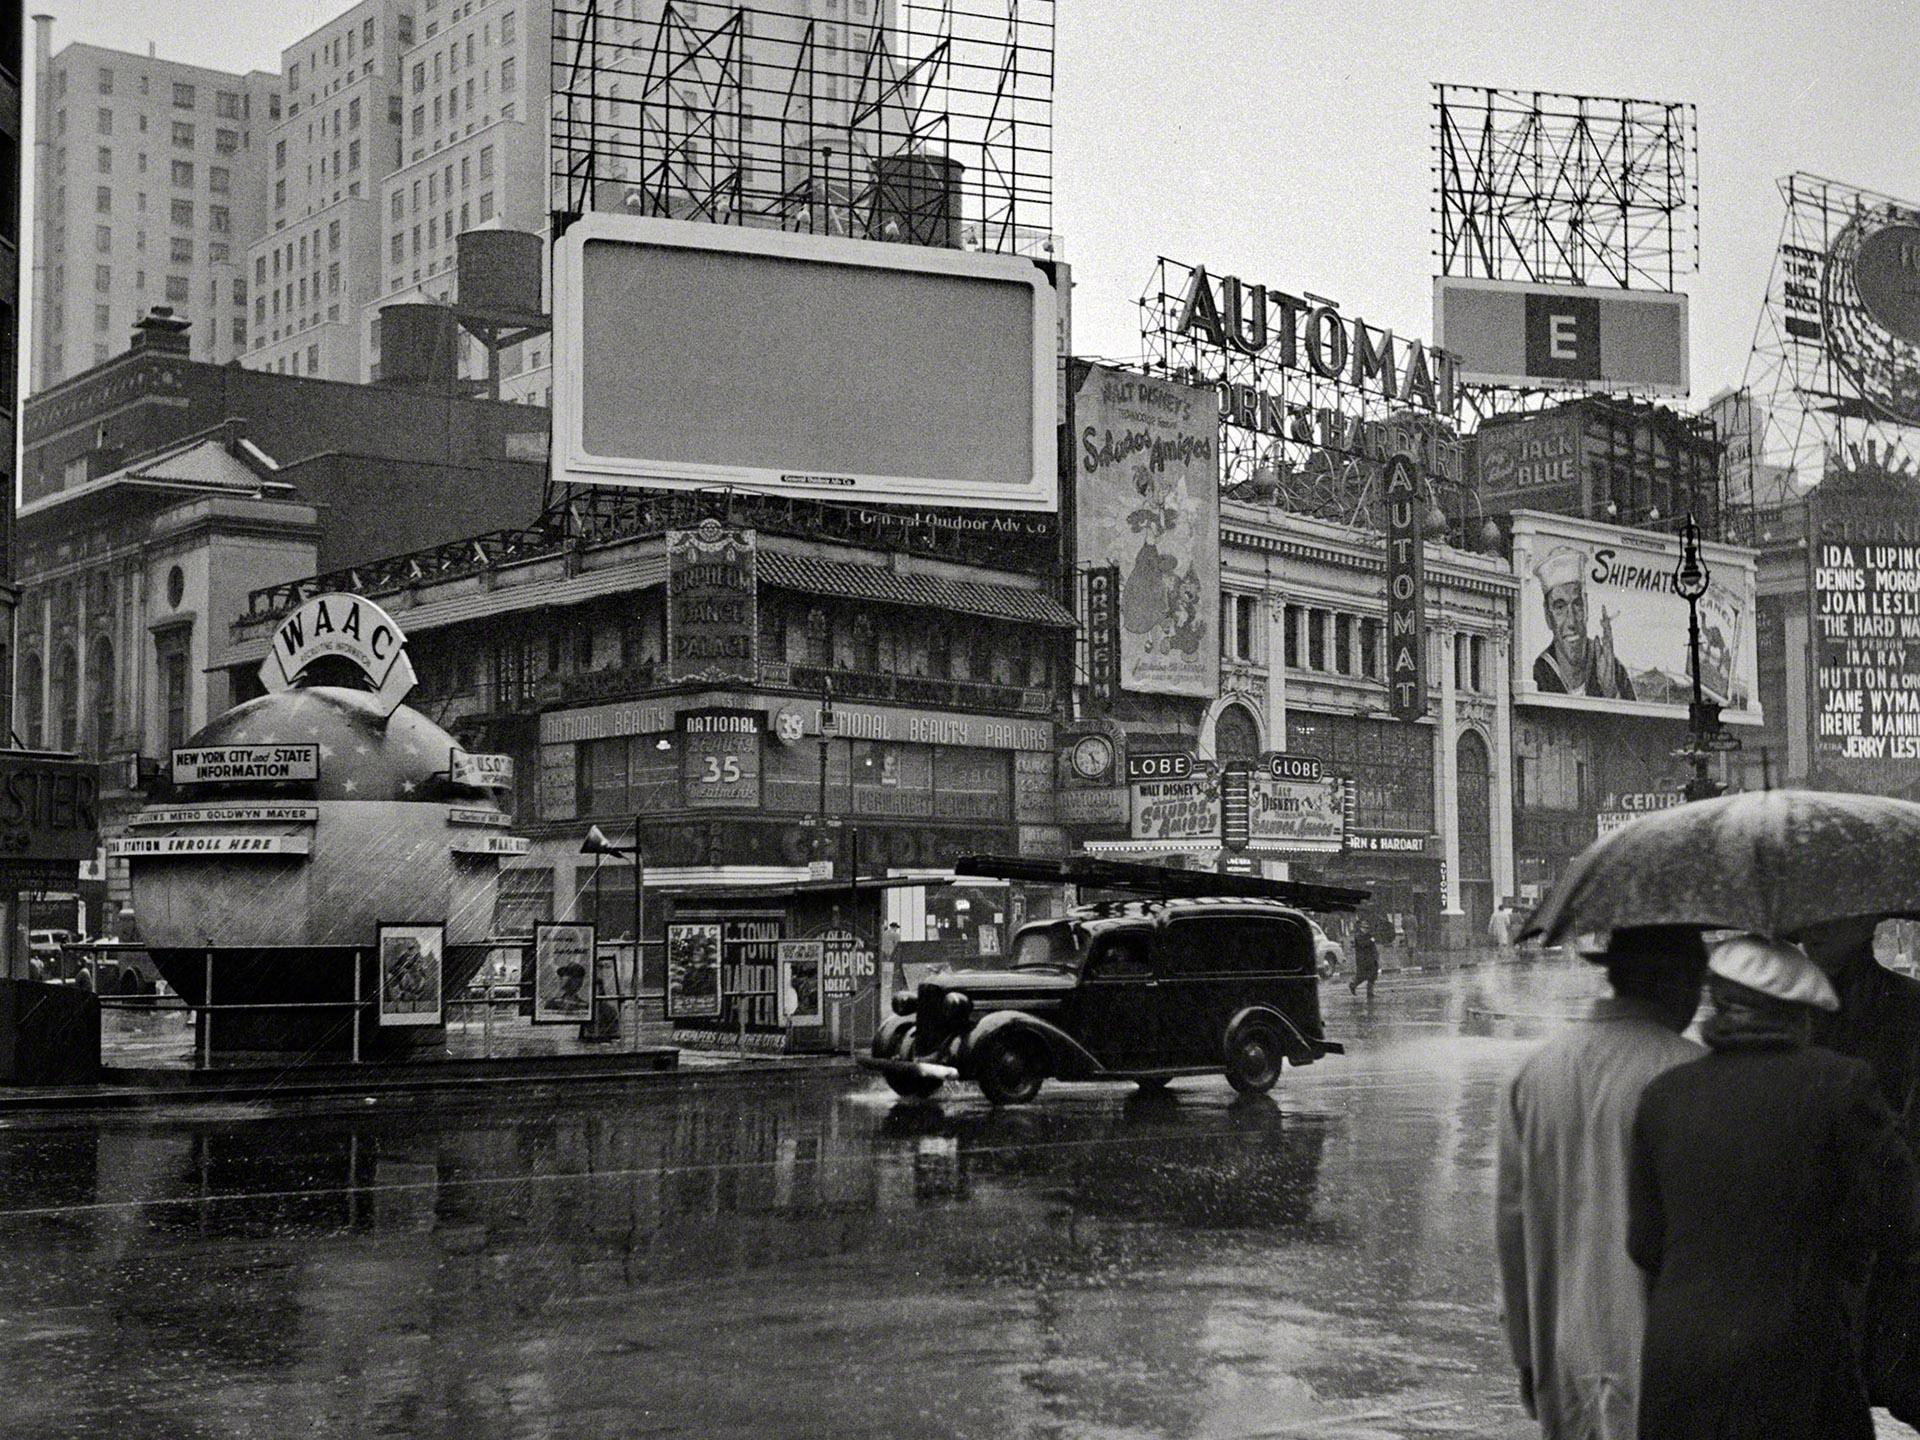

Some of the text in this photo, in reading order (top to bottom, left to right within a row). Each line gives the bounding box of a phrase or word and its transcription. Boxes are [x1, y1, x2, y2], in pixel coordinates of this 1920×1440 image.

[1176, 263, 1463, 416] AUTOMAT
[1550, 314, 1578, 360] E
[1212, 380, 1285, 437] ORN
[1520, 437, 1573, 462] JACK
[1518, 459, 1575, 487] BLUE
[925, 511, 989, 531] Outdoor
[990, 515, 1021, 533] Adv
[1823, 545, 1854, 568] IDA
[1388, 461, 1417, 708] AUTOMAT
[1815, 567, 1866, 592] DENNIS
[1821, 591, 1867, 614] JOAN
[279, 600, 394, 661] WAAC
[1853, 615, 1896, 638] HARD
[1846, 650, 1907, 667] INA RAY
[1820, 667, 1887, 690] HUTTON
[1825, 689, 1864, 713] JANE
[547, 707, 667, 742] NATIONAL BEAUTY
[686, 715, 758, 733] NATIONAL
[815, 708, 1047, 751] NTIONAL BEAUTY PARLORS
[1820, 712, 1920, 737] IRENE MANNI
[177, 754, 199, 767] NEW
[201, 751, 226, 765] YORK
[229, 749, 253, 763] CITY
[274, 748, 312, 763] STATE
[1842, 735, 1886, 759] JERRY
[196, 763, 290, 779] INFORMATION
[701, 755, 741, 784] 35
[1129, 758, 1186, 775] LOBE
[1272, 759, 1320, 777] GLOBE
[1139, 785, 1160, 797] WALT
[170, 811, 201, 822] METRO
[206, 809, 261, 820] GOLDWYN
[266, 808, 307, 819] MAYER
[124, 840, 161, 852] STATION
[167, 838, 222, 851] ENROLL
[228, 838, 273, 851] HERE
[1369, 838, 1378, 850] &
[1380, 838, 1424, 851] HARDART
